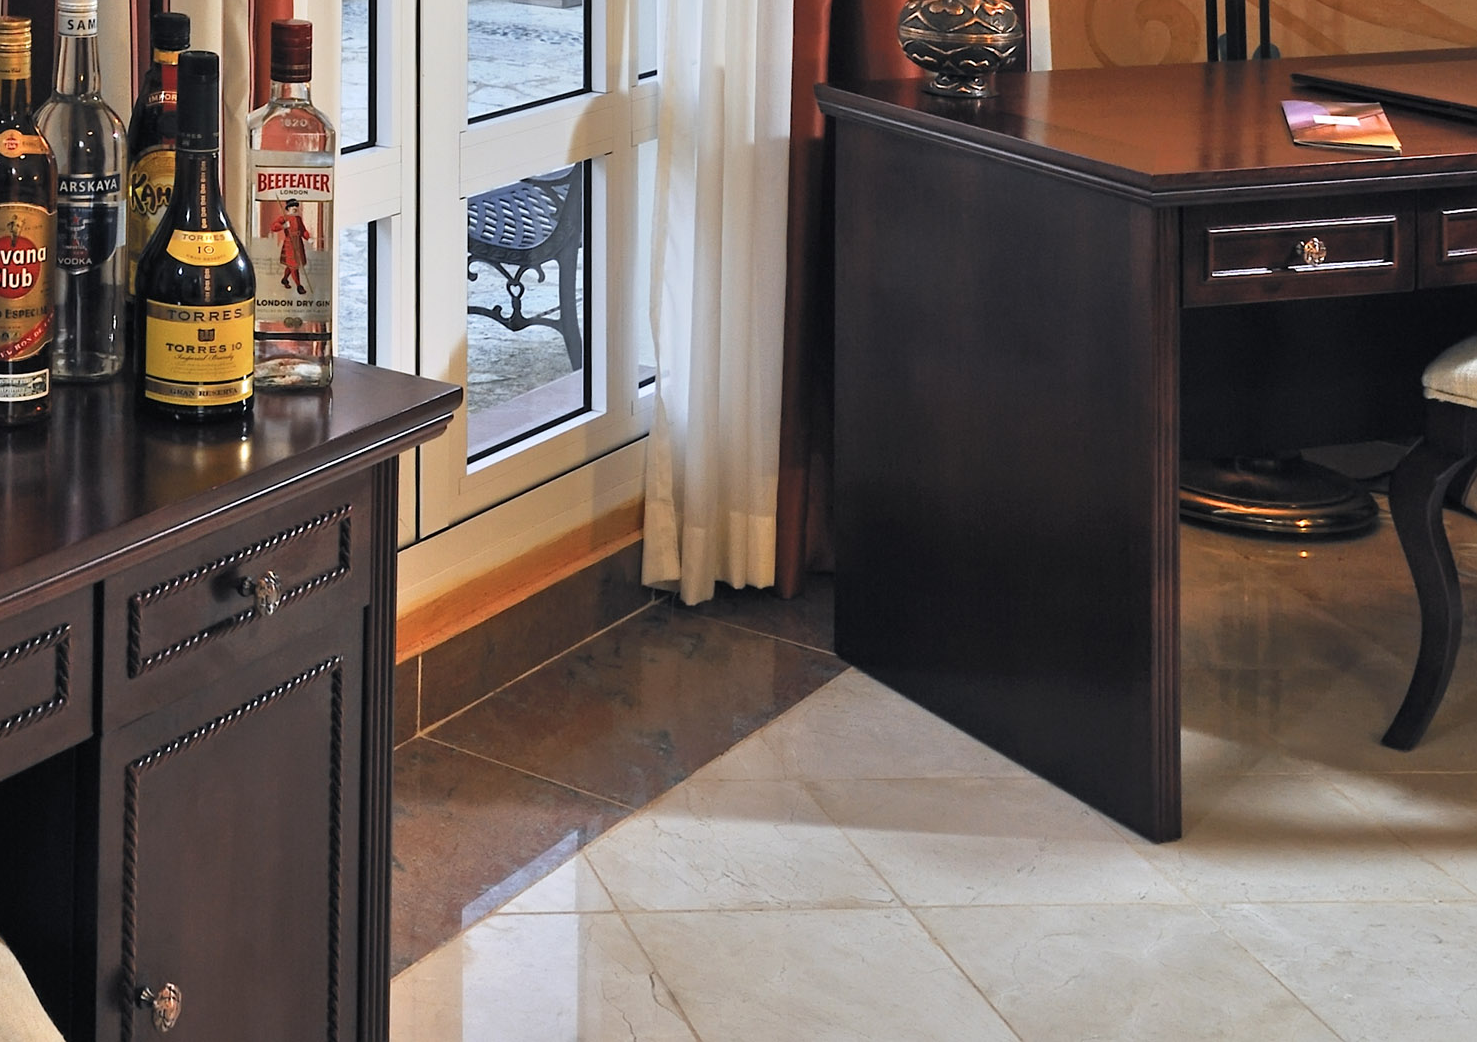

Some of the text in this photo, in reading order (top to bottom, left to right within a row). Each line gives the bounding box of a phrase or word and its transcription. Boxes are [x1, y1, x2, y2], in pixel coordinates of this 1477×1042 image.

[257, 173, 330, 193] BEEFEATER
[181, 233, 226, 241] TORRES
[197, 245, 214, 255] 10
[57, 257, 93, 266] VODKA
[256, 299, 293, 307] LONDON
[167, 308, 243, 322] TORRES
[166, 342, 243, 354] TORRES 10
